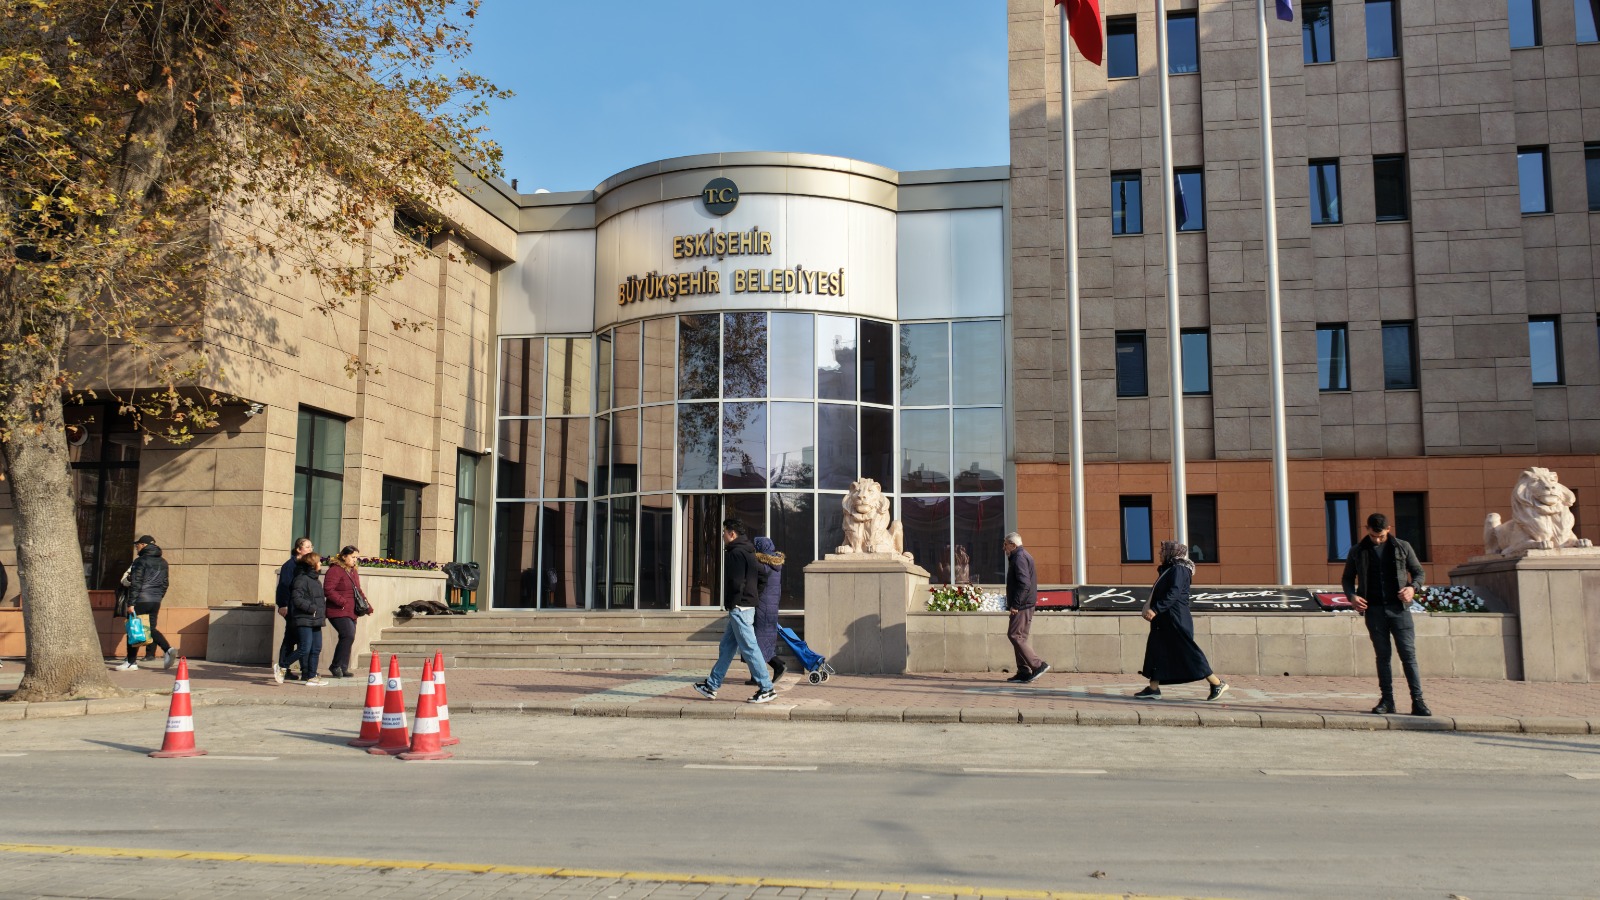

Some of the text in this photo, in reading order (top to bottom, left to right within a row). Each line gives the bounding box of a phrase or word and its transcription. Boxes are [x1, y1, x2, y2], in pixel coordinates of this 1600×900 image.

[704, 187, 737, 204] T.C.
[673, 226, 772, 260] ESKİŞEHİR
[618, 265, 845, 305] BÜYÜKŞEHİR BELEDİYESİ
